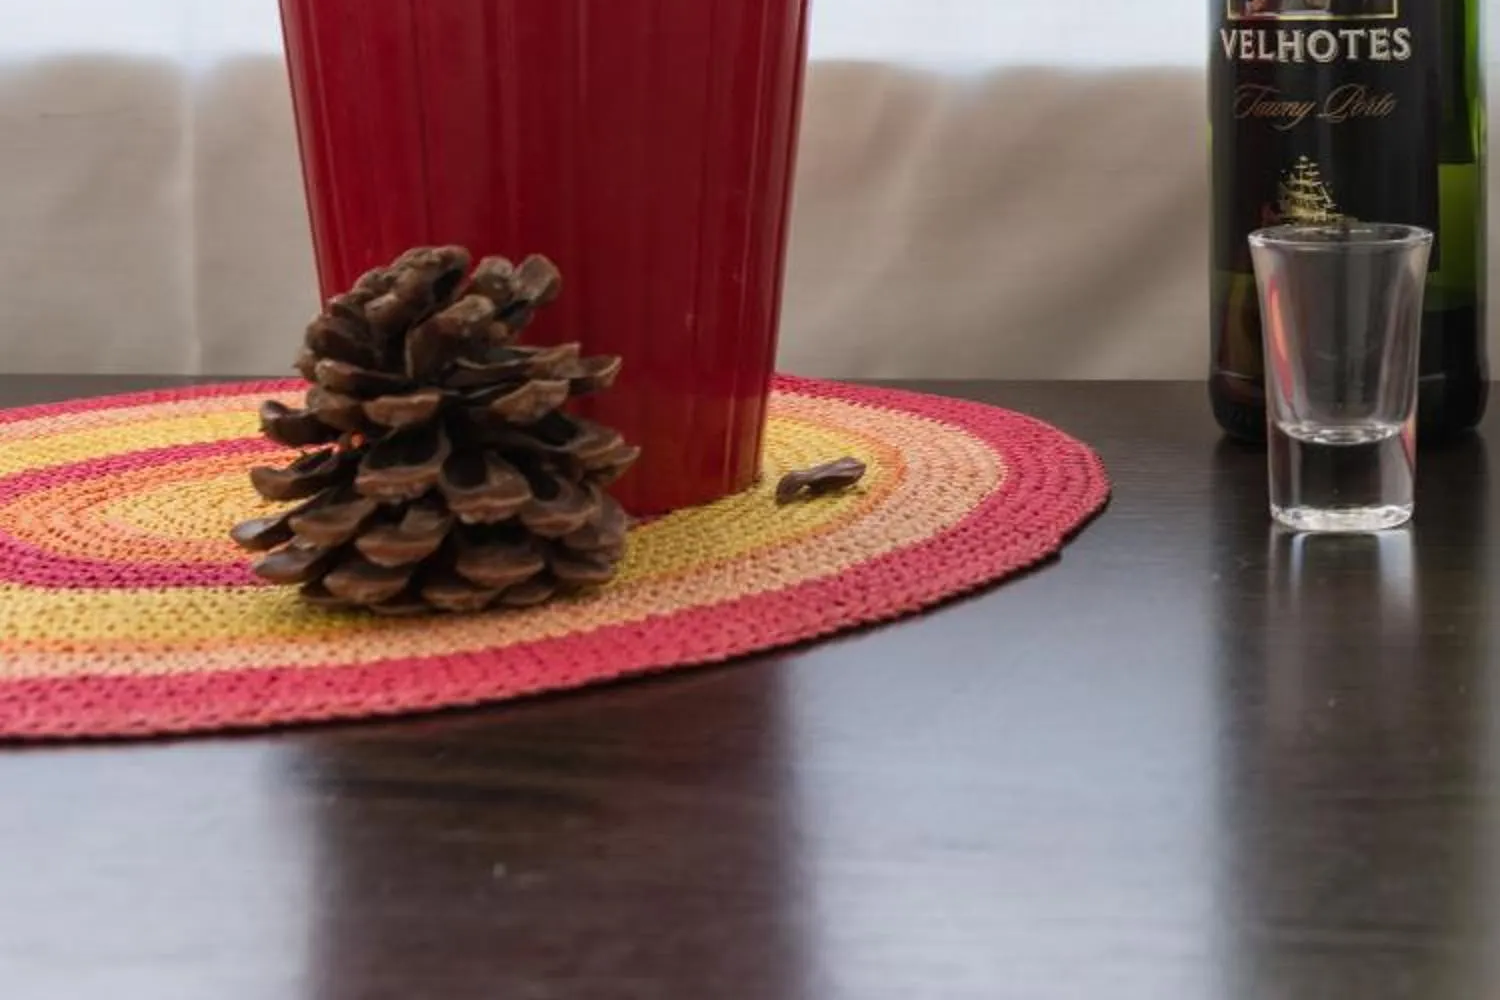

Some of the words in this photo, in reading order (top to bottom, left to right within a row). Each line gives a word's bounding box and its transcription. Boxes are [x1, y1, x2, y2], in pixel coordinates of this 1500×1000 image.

[1219, 26, 1412, 63] VELHOTES
[1233, 82, 1318, 132] Tawny
[1316, 82, 1397, 124] Porto
